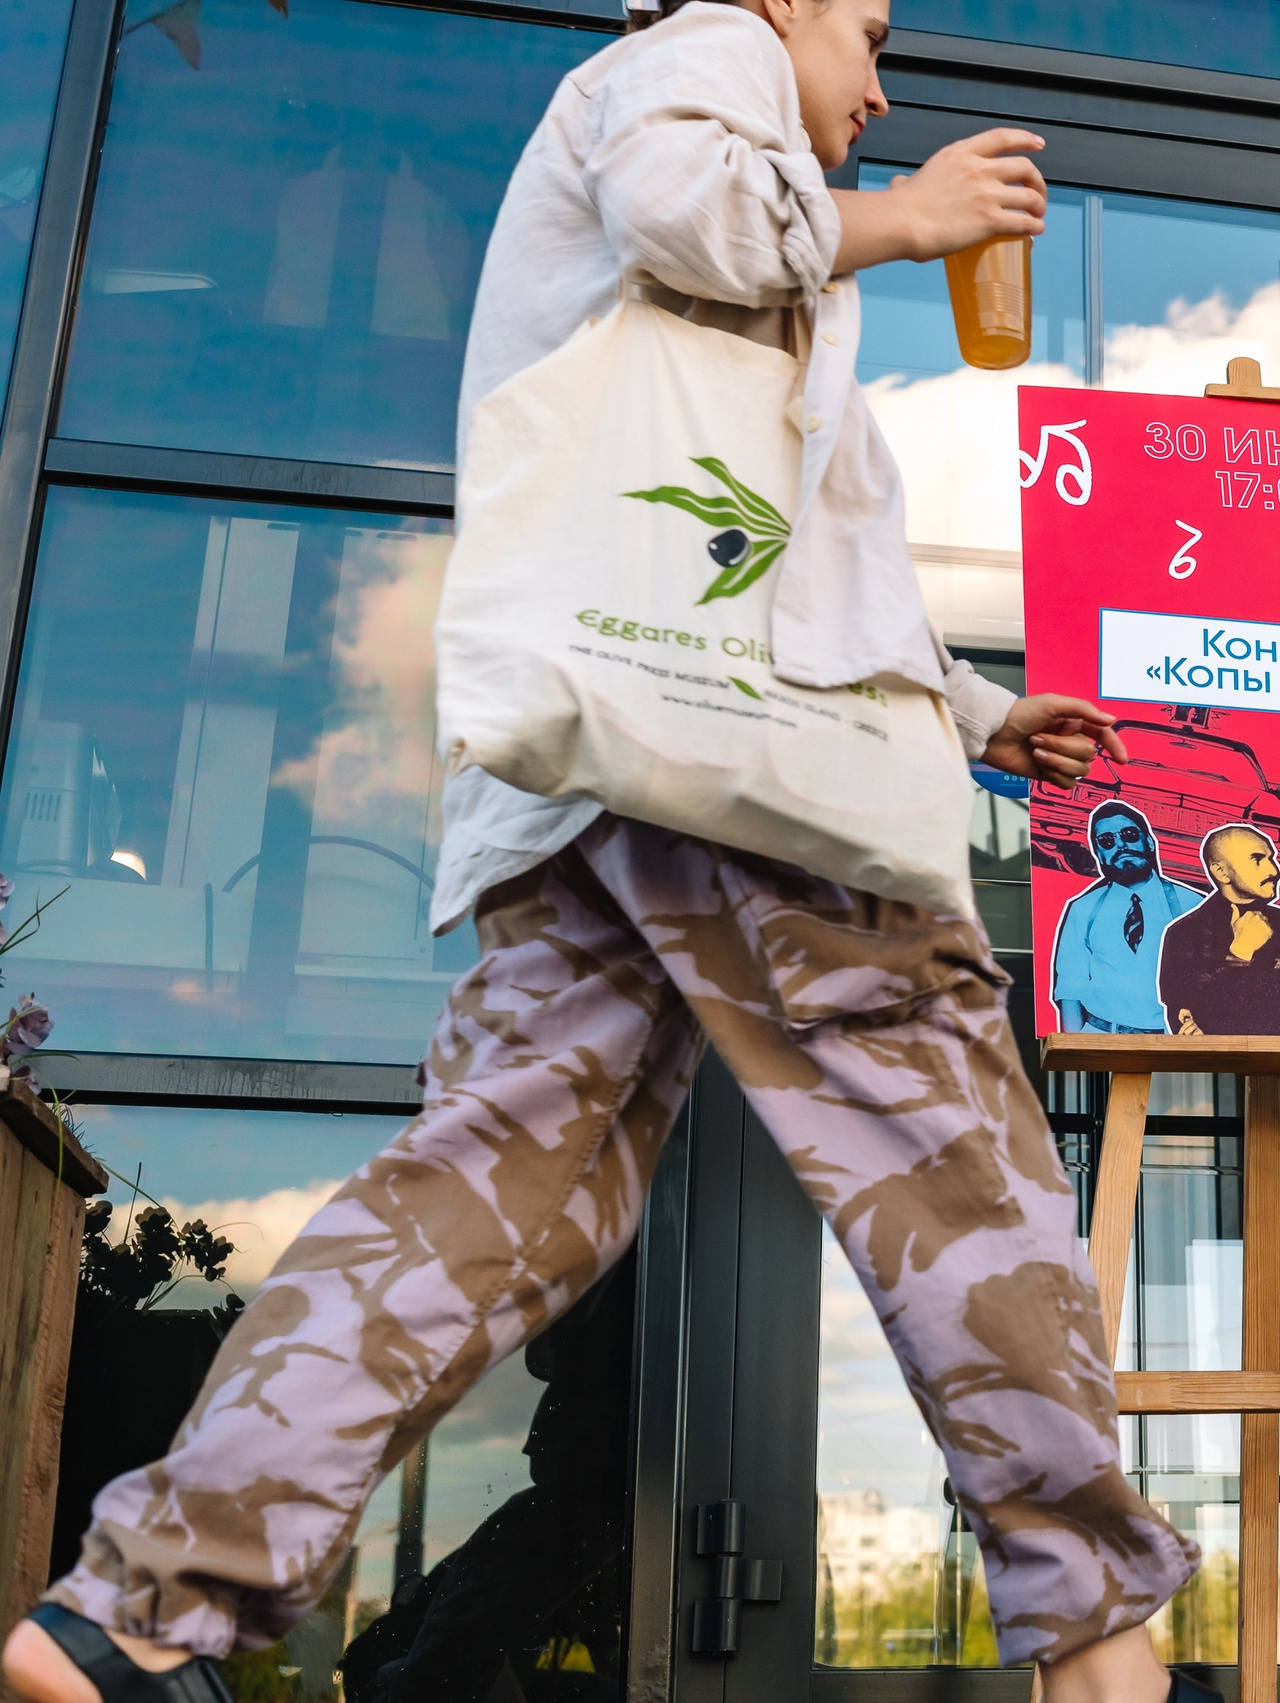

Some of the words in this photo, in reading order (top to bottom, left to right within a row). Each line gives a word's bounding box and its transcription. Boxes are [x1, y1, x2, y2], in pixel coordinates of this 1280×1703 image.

[1143, 421, 1207, 462] 30
[574, 609, 708, 651] Eggares
[721, 637, 774, 664] Oli
[1146, 655, 1271, 694] «Копы
